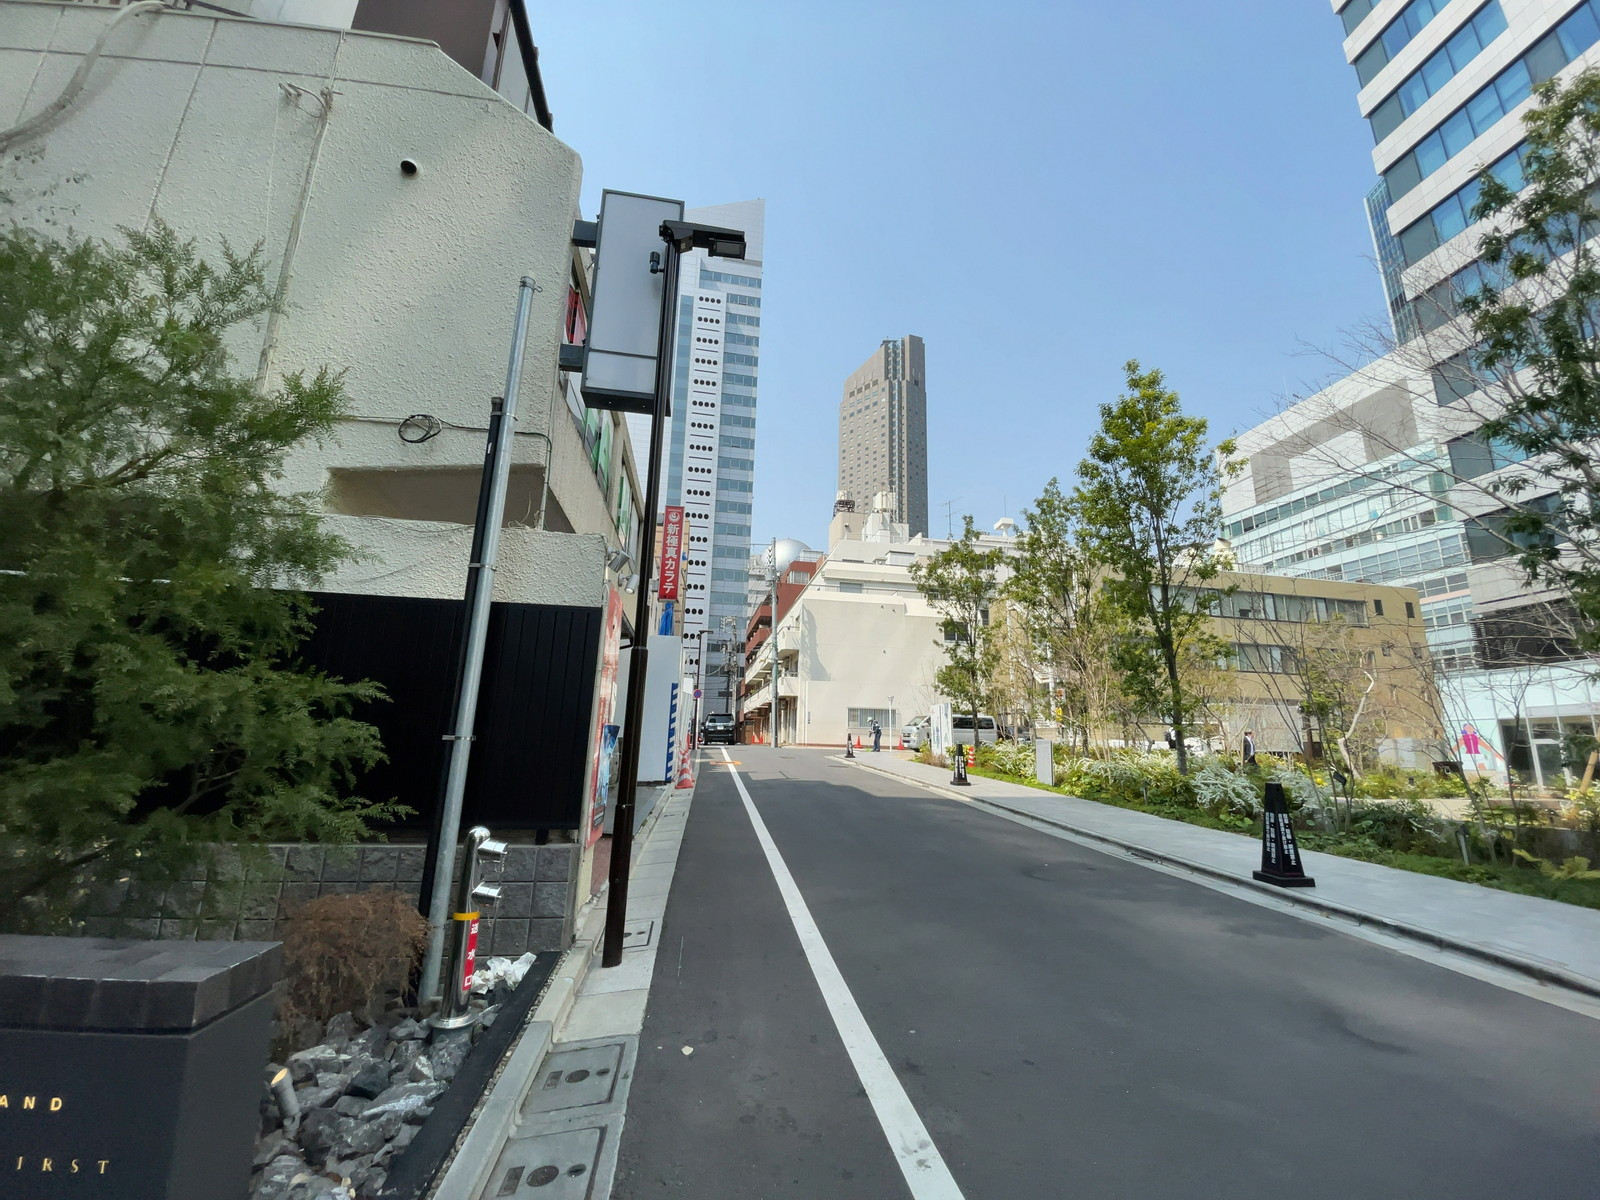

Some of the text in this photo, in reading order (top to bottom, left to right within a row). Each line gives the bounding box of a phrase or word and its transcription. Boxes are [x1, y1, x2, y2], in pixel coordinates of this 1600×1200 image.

[663, 523, 680, 594] 新極真カラテ
[464, 922, 479, 987] 送水口
[0, 1094, 63, 1112] AND
[16, 1156, 110, 1175] IRST
